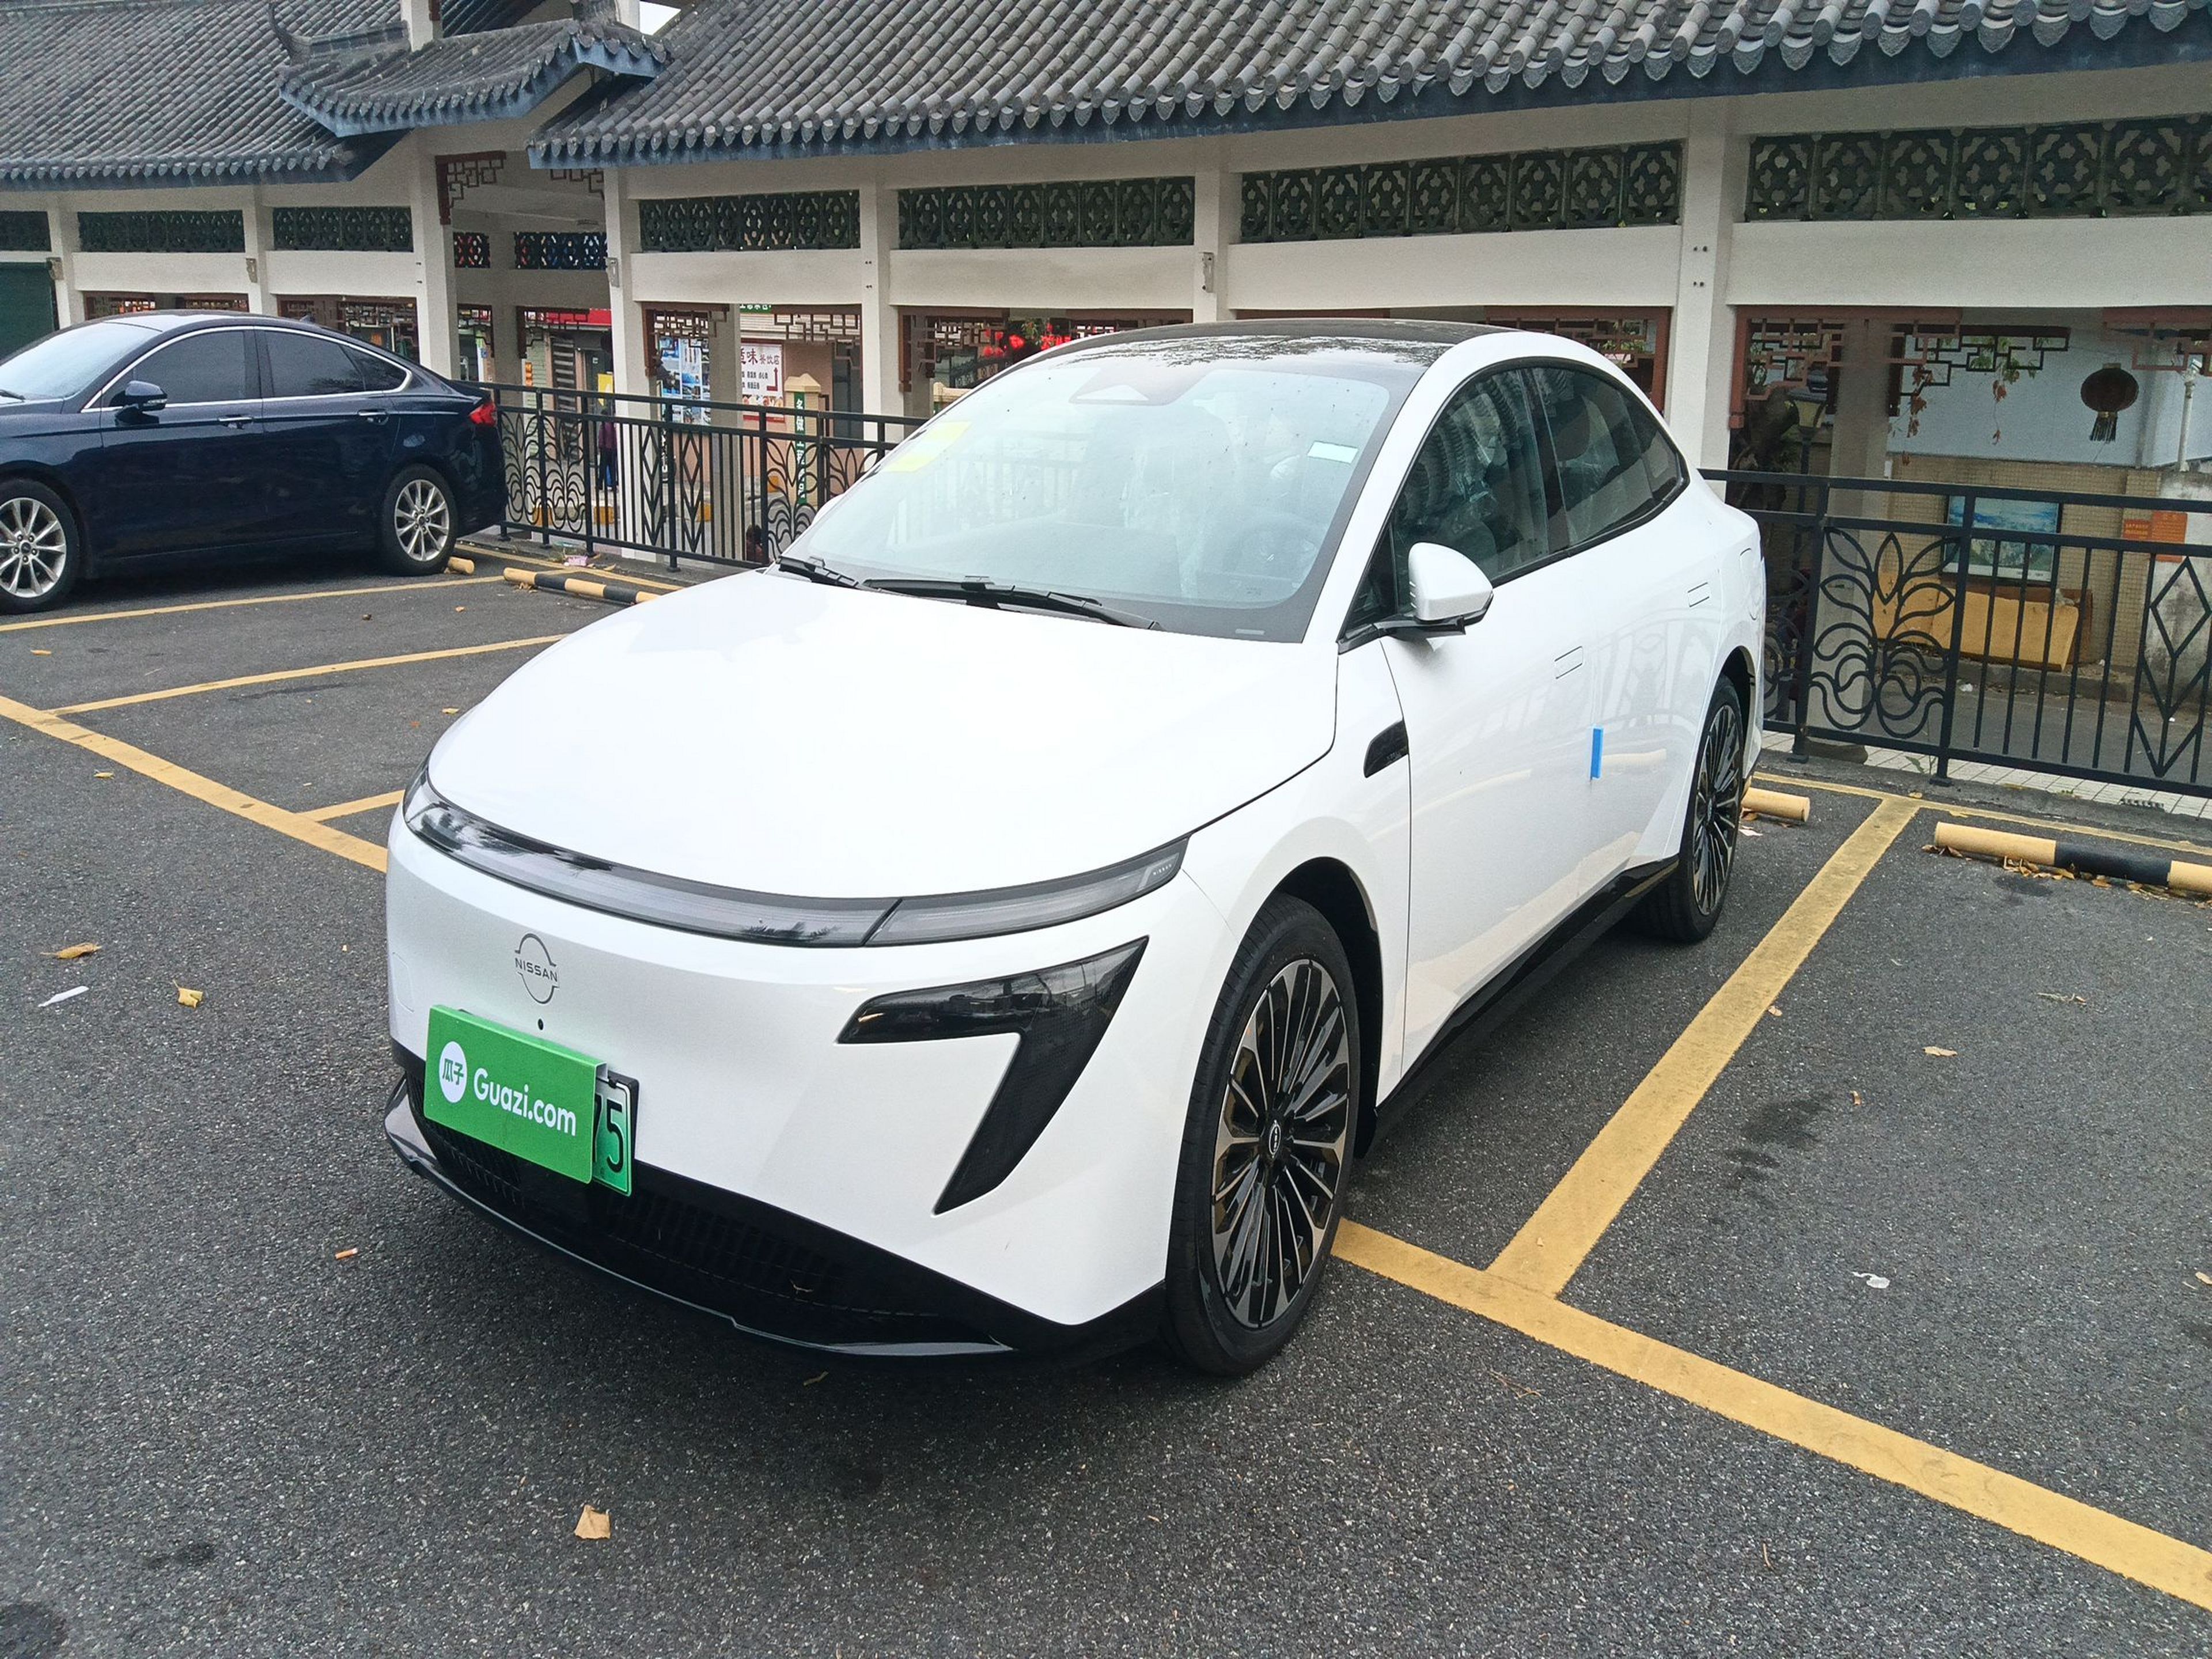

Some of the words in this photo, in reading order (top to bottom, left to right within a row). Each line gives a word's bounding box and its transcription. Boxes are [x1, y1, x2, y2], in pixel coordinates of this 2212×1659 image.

[515, 958, 558, 982] NISSAN
[442, 1058, 464, 1086] 瓜子
[474, 1067, 576, 1137] Guazi.com
